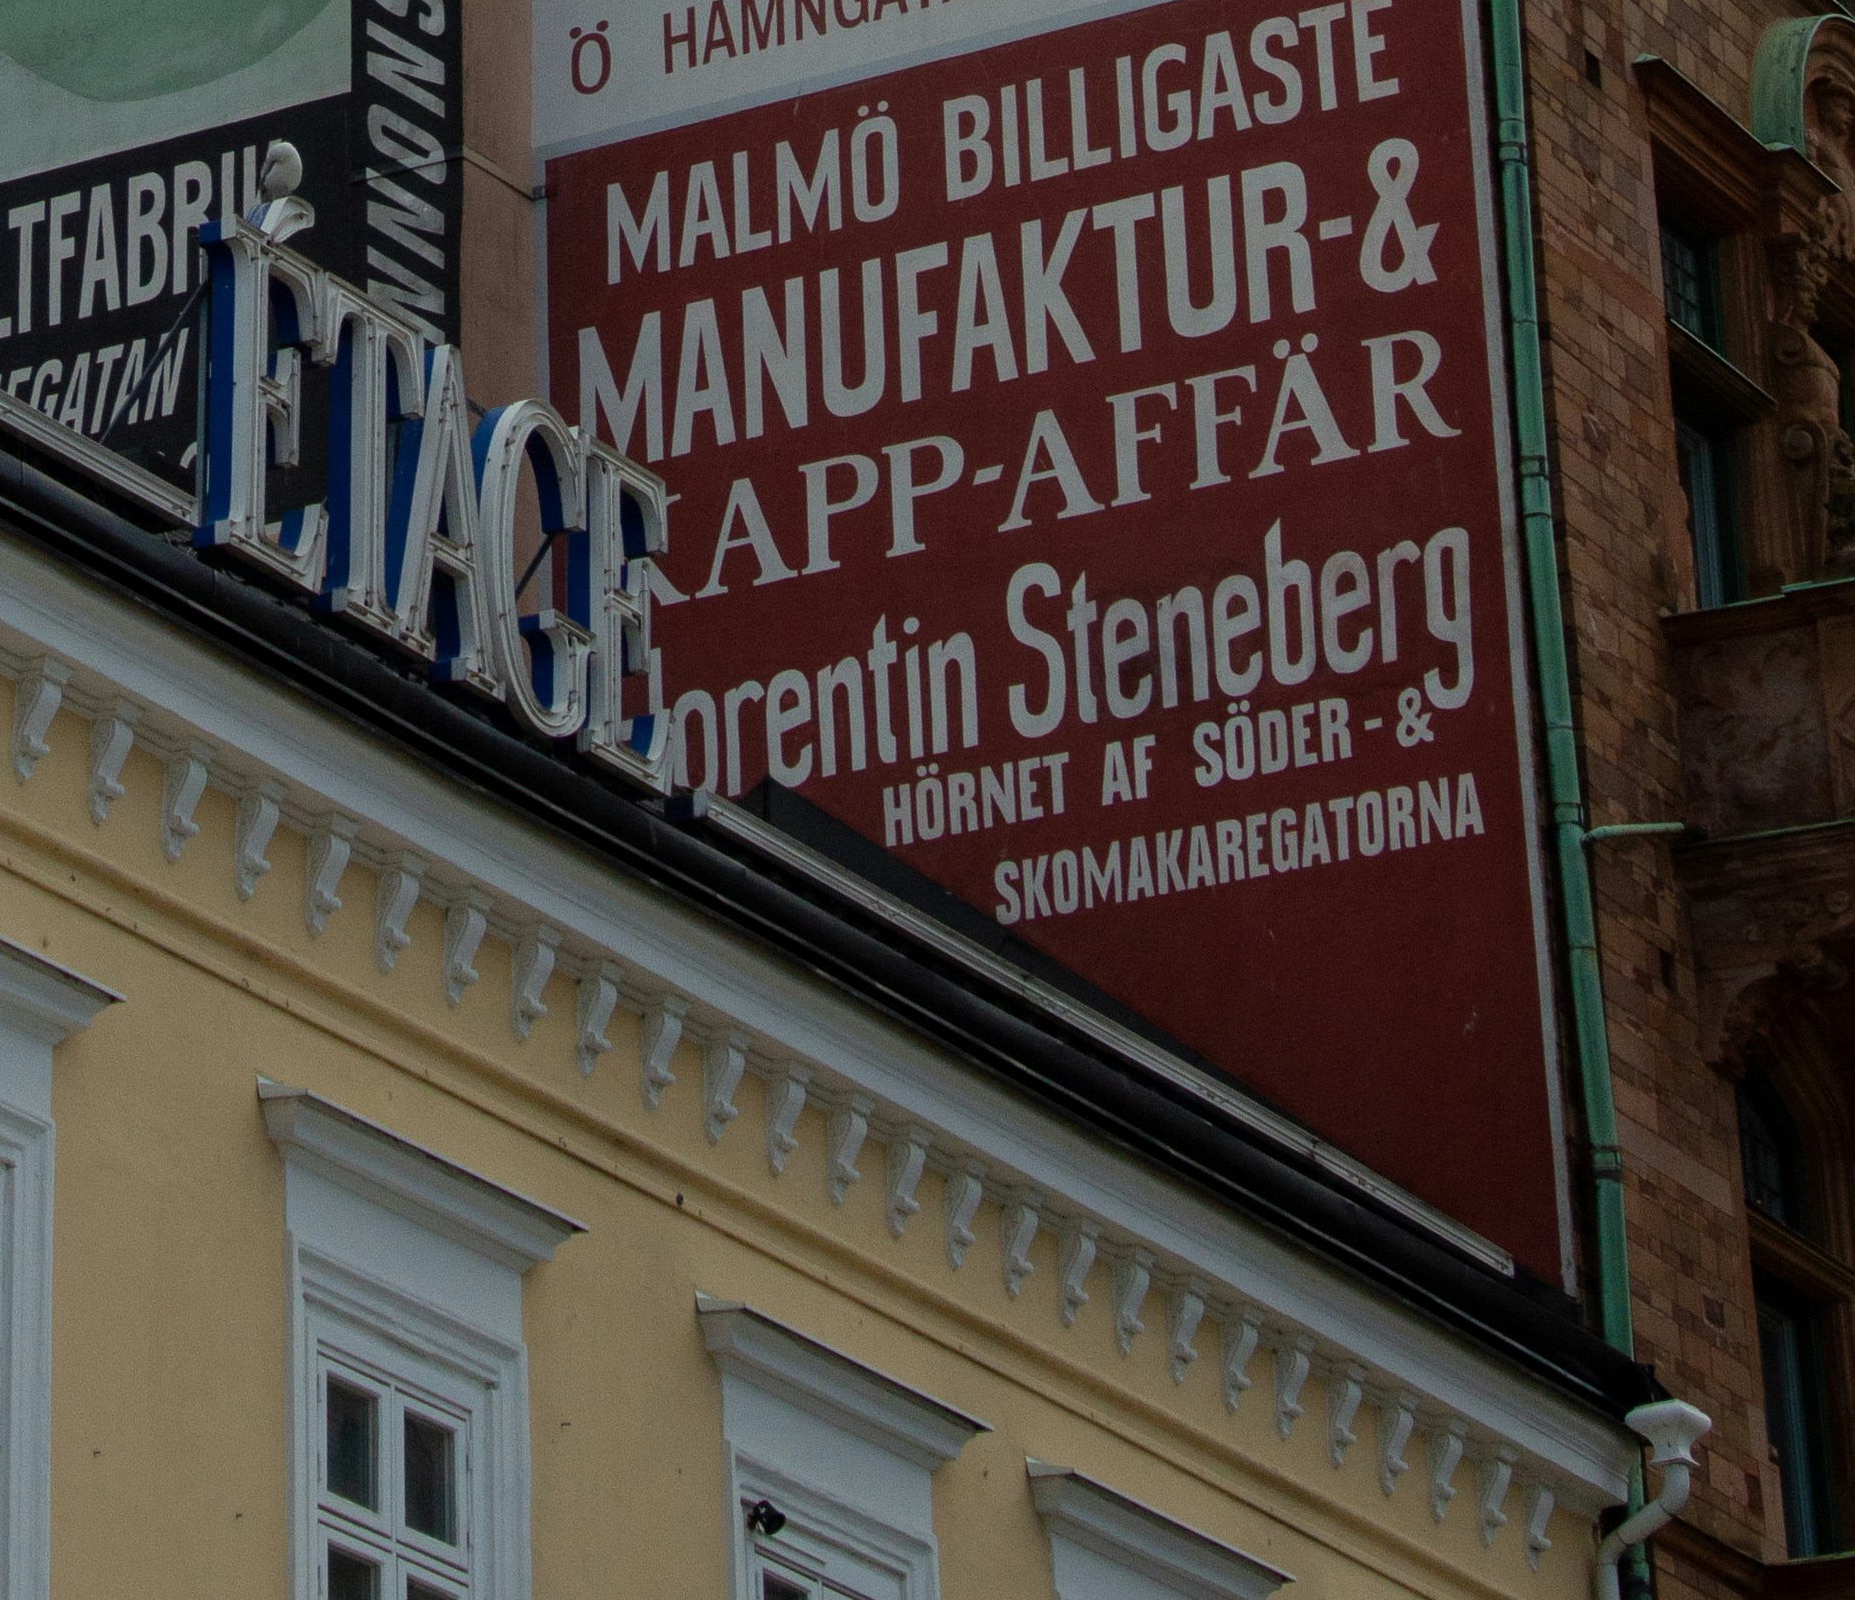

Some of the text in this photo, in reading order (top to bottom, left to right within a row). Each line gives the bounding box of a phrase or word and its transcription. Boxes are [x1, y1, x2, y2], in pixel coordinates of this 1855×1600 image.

[569, 20, 612, 96] Ö
[606, 100, 900, 285] MALMÖ
[648, 329, 1462, 608] APP-AFFÄR
[1006, 517, 1476, 739] Steneberg
[883, 751, 1069, 848] HÖRNET
[1101, 734, 1156, 805] AF
[993, 772, 1486, 927] SKOMAKAREGATORNA
